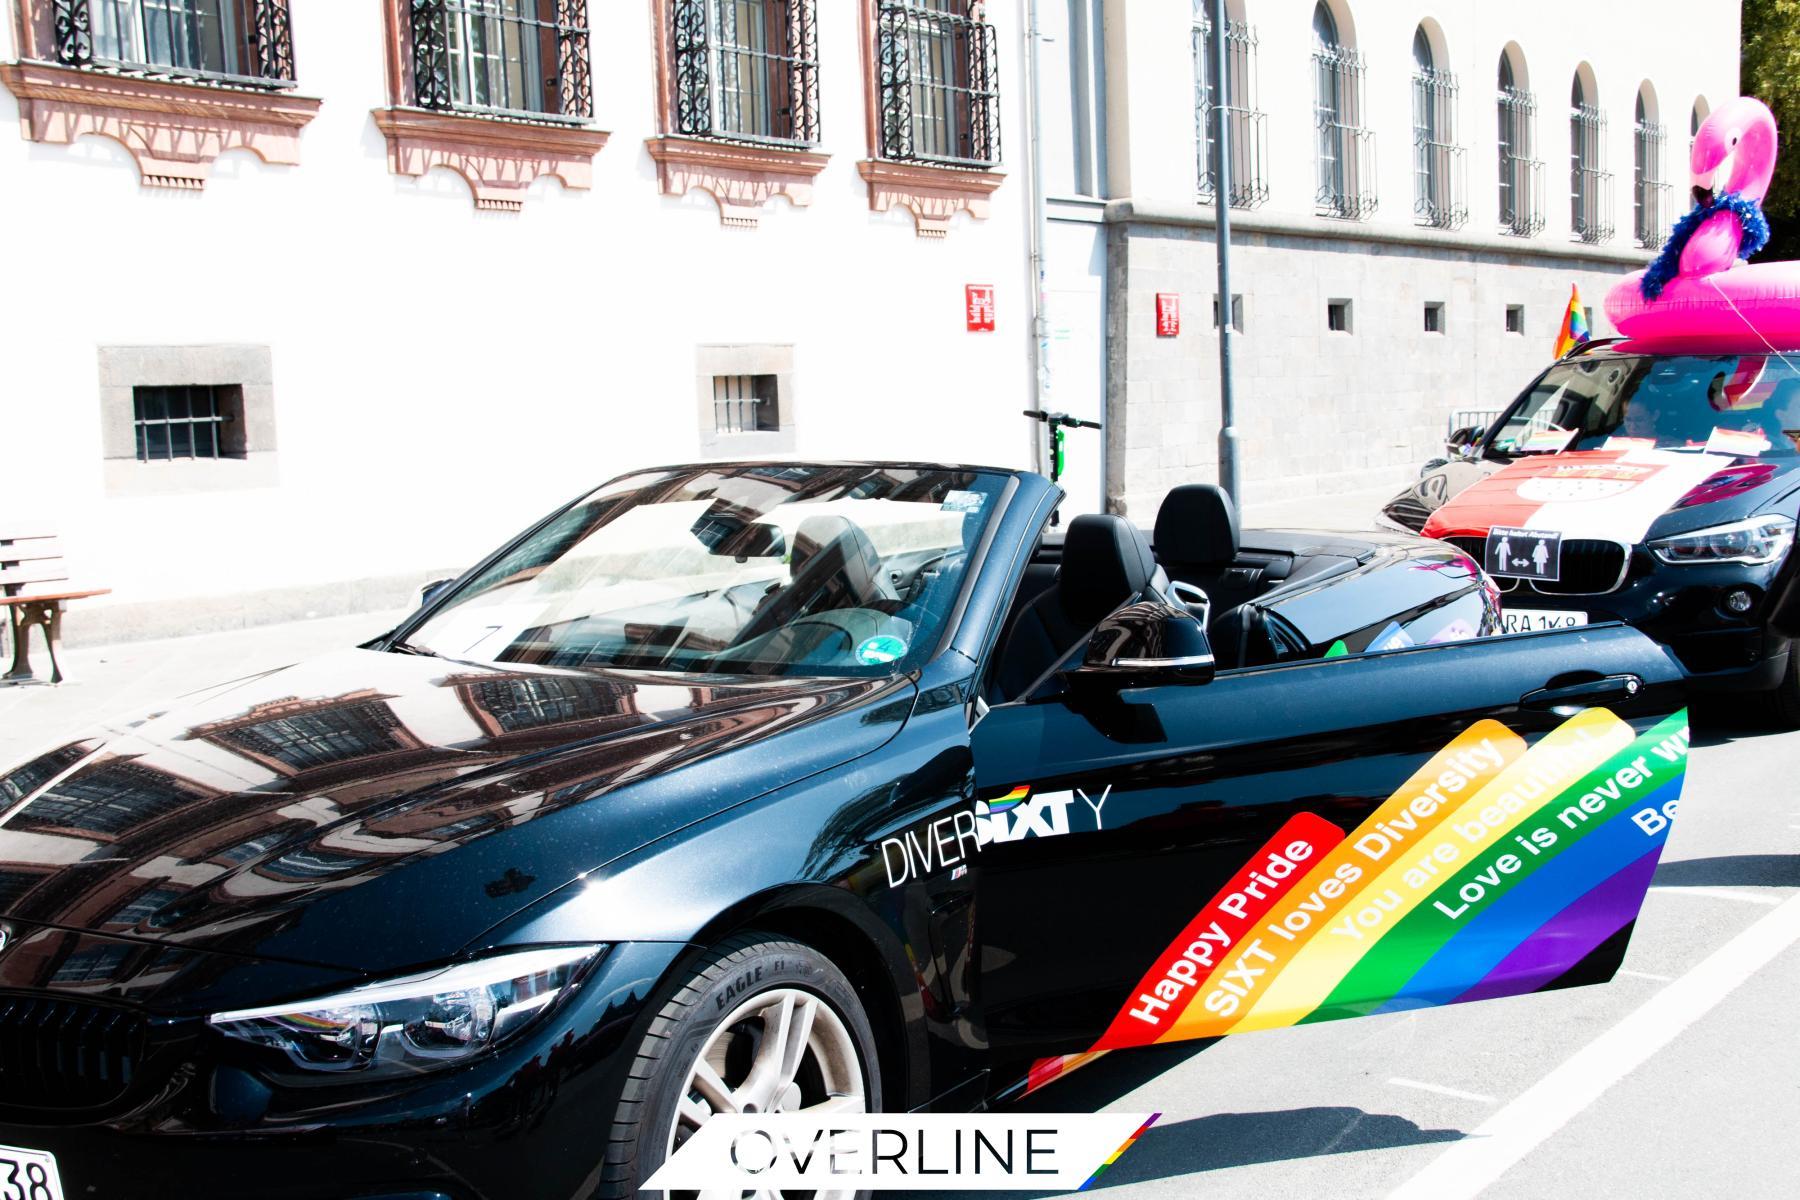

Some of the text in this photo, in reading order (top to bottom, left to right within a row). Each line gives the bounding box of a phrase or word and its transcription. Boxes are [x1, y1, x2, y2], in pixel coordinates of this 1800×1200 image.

[1205, 738, 1505, 1018] SIXT loves Diversity
[1330, 728, 1598, 940] You are beautil
[1433, 853, 1522, 919] Love
[1514, 828, 1558, 855] is
[1556, 756, 1653, 829] never
[716, 966, 763, 1012] EAGLE
[1129, 840, 1313, 1025] Happy Pride
